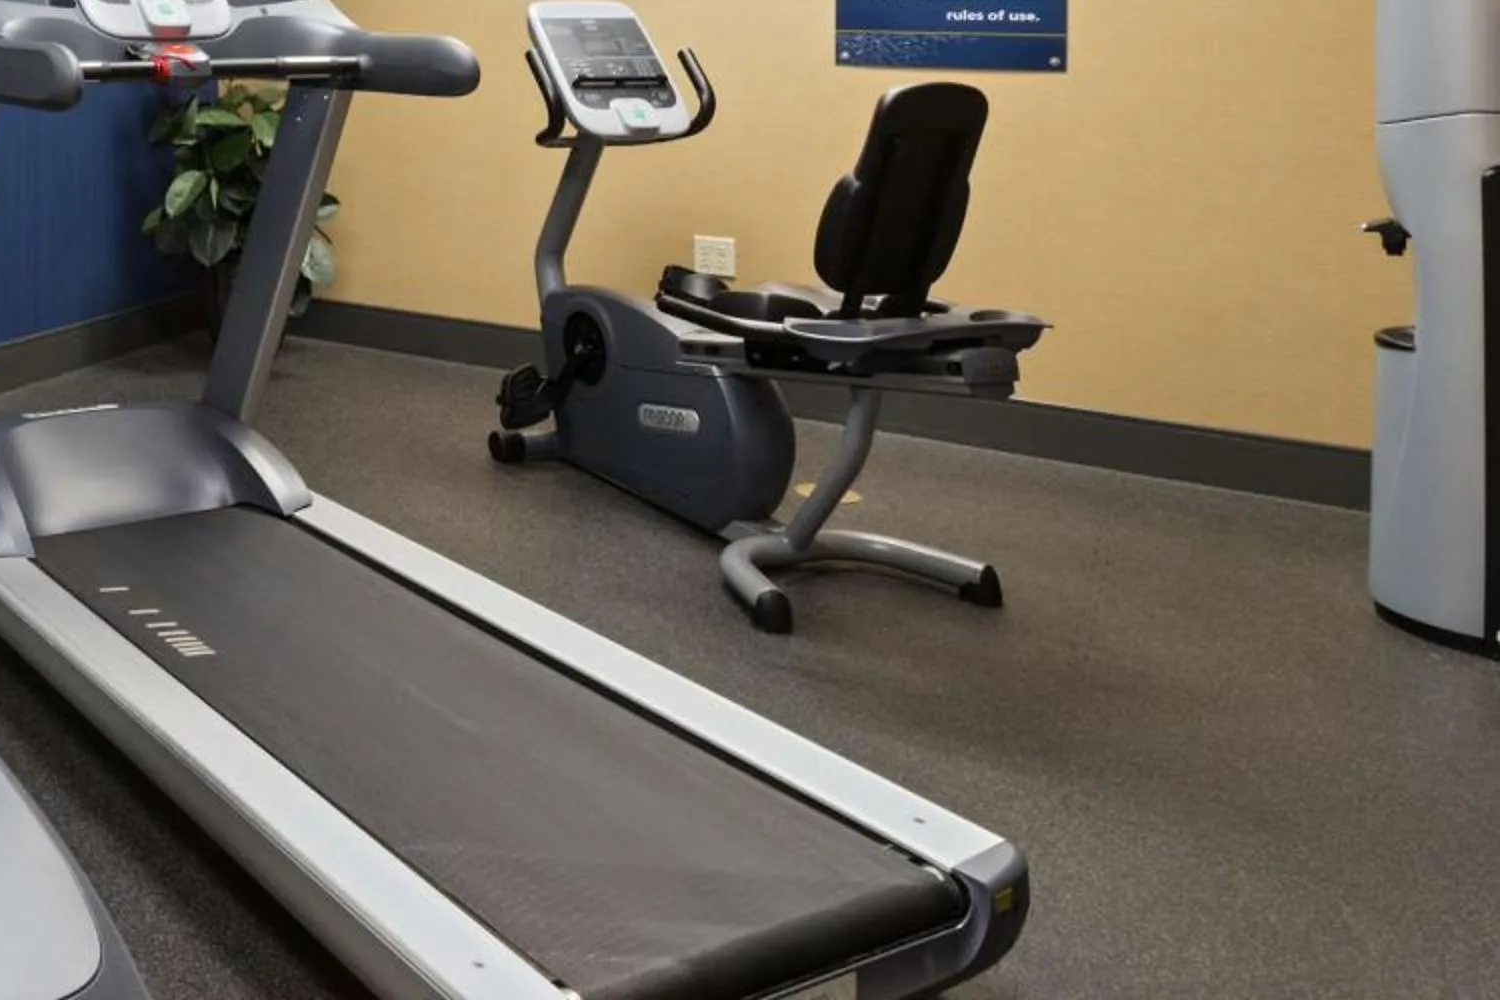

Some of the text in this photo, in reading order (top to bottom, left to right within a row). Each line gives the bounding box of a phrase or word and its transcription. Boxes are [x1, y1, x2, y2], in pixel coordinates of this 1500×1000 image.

[946, 9, 1041, 22] rules of use.
